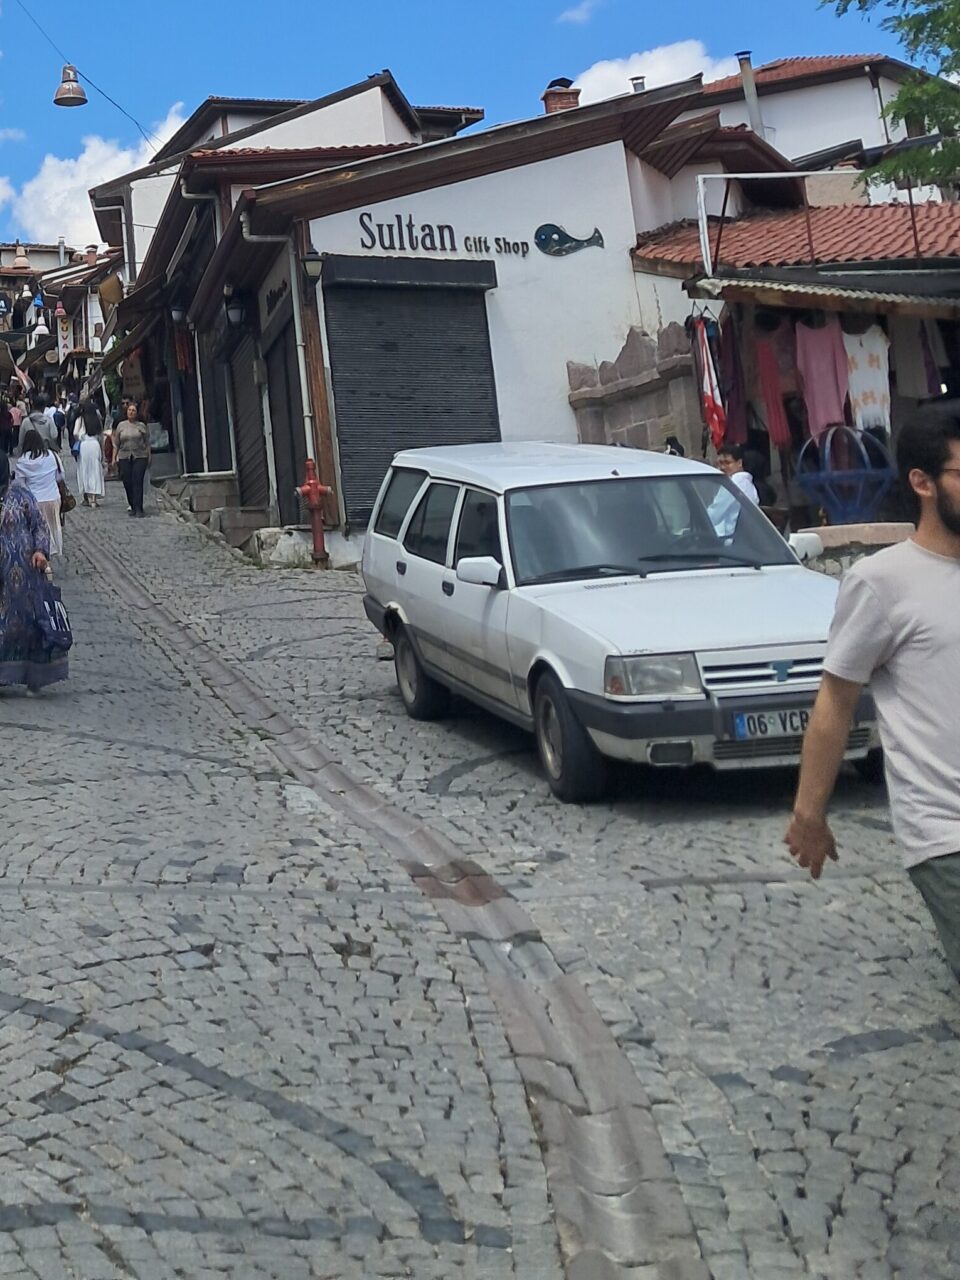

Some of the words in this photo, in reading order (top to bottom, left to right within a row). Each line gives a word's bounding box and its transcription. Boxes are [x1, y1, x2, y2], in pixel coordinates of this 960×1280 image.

[358, 212, 458, 252] Sultan
[464, 235, 490, 253] Gift
[494, 237, 530, 258] Shop
[746, 714, 768, 735] 06
